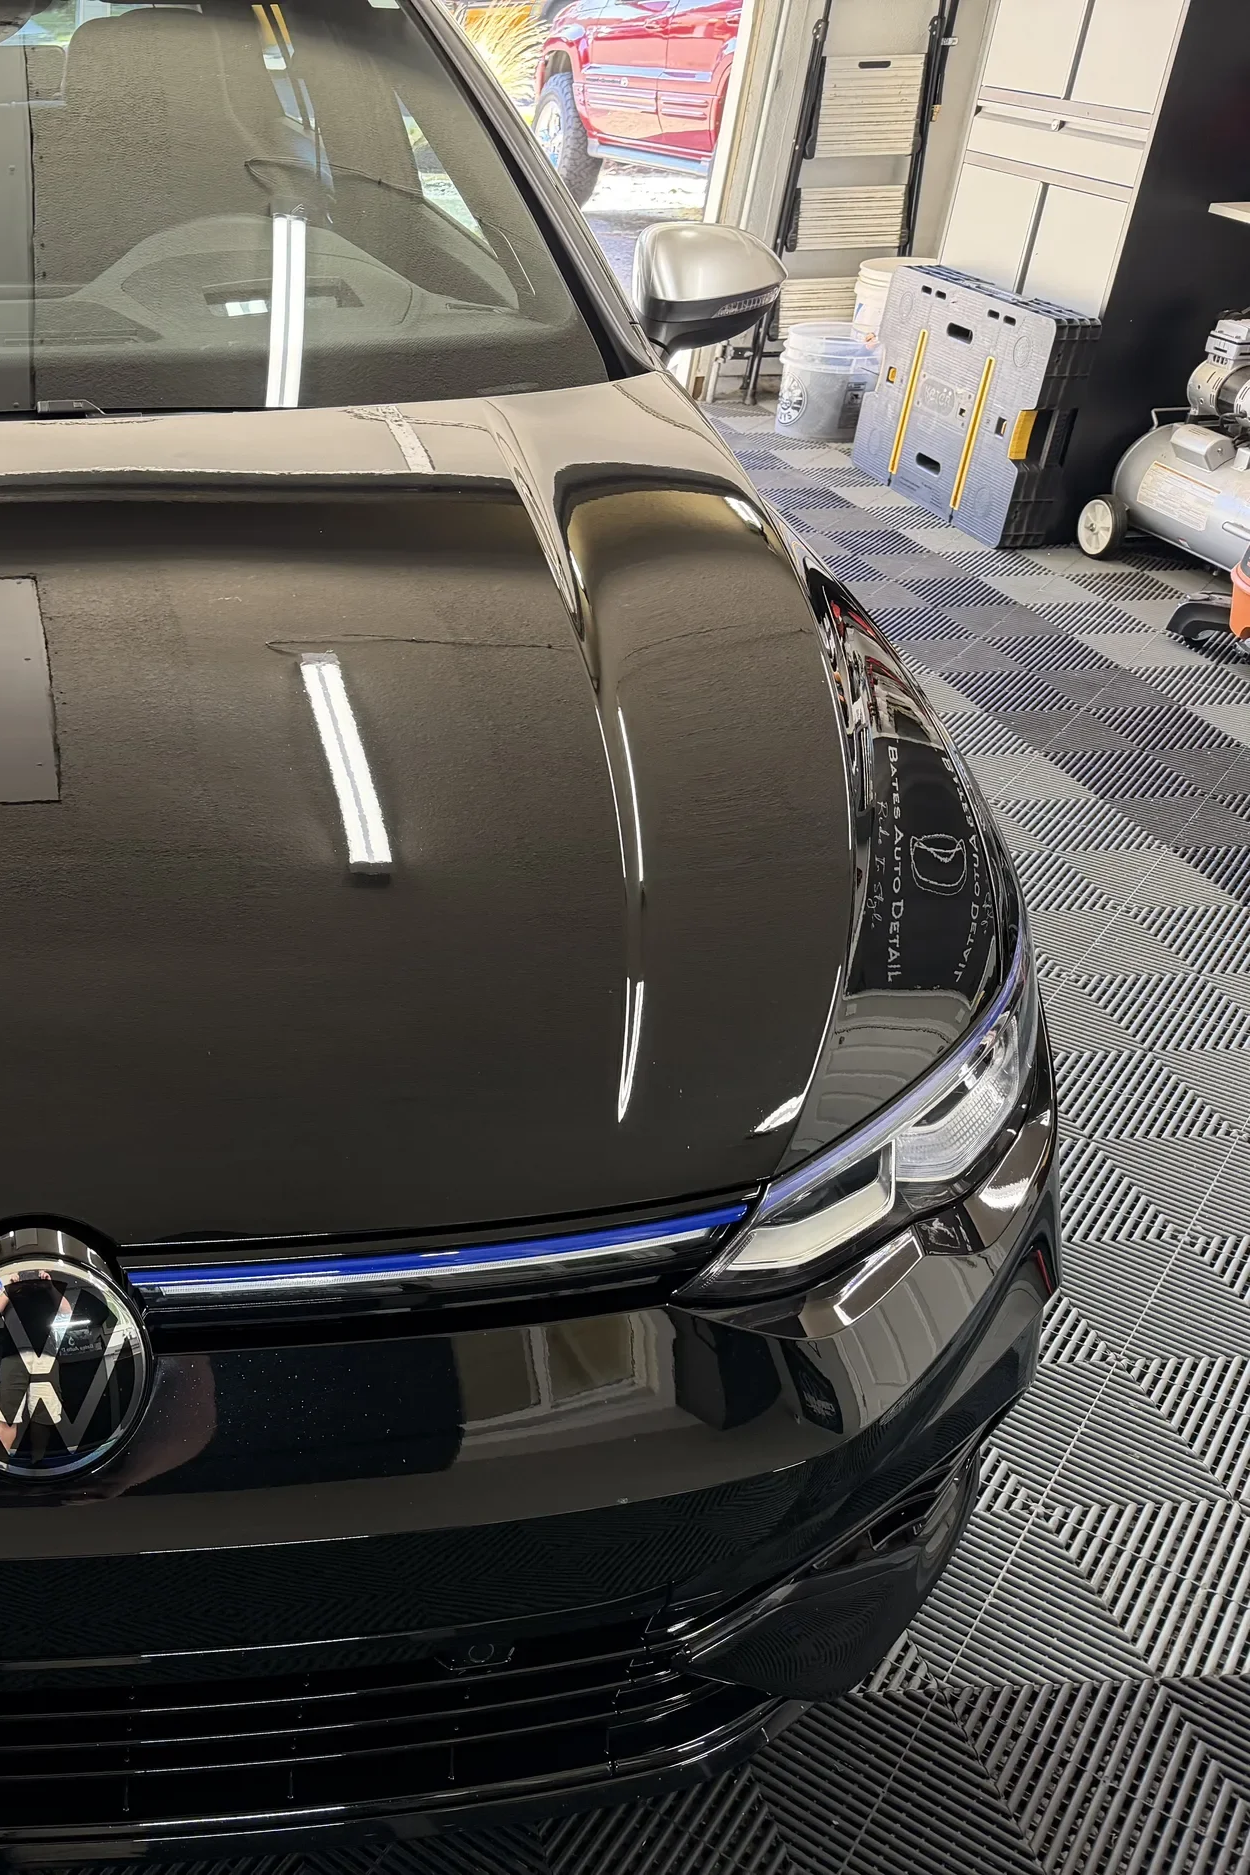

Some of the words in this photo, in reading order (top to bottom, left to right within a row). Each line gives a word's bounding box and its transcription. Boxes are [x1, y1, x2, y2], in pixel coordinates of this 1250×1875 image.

[888, 745, 901, 820] BATES
[893, 824, 905, 894] AUTO
[887, 899, 904, 982] DETAIL
